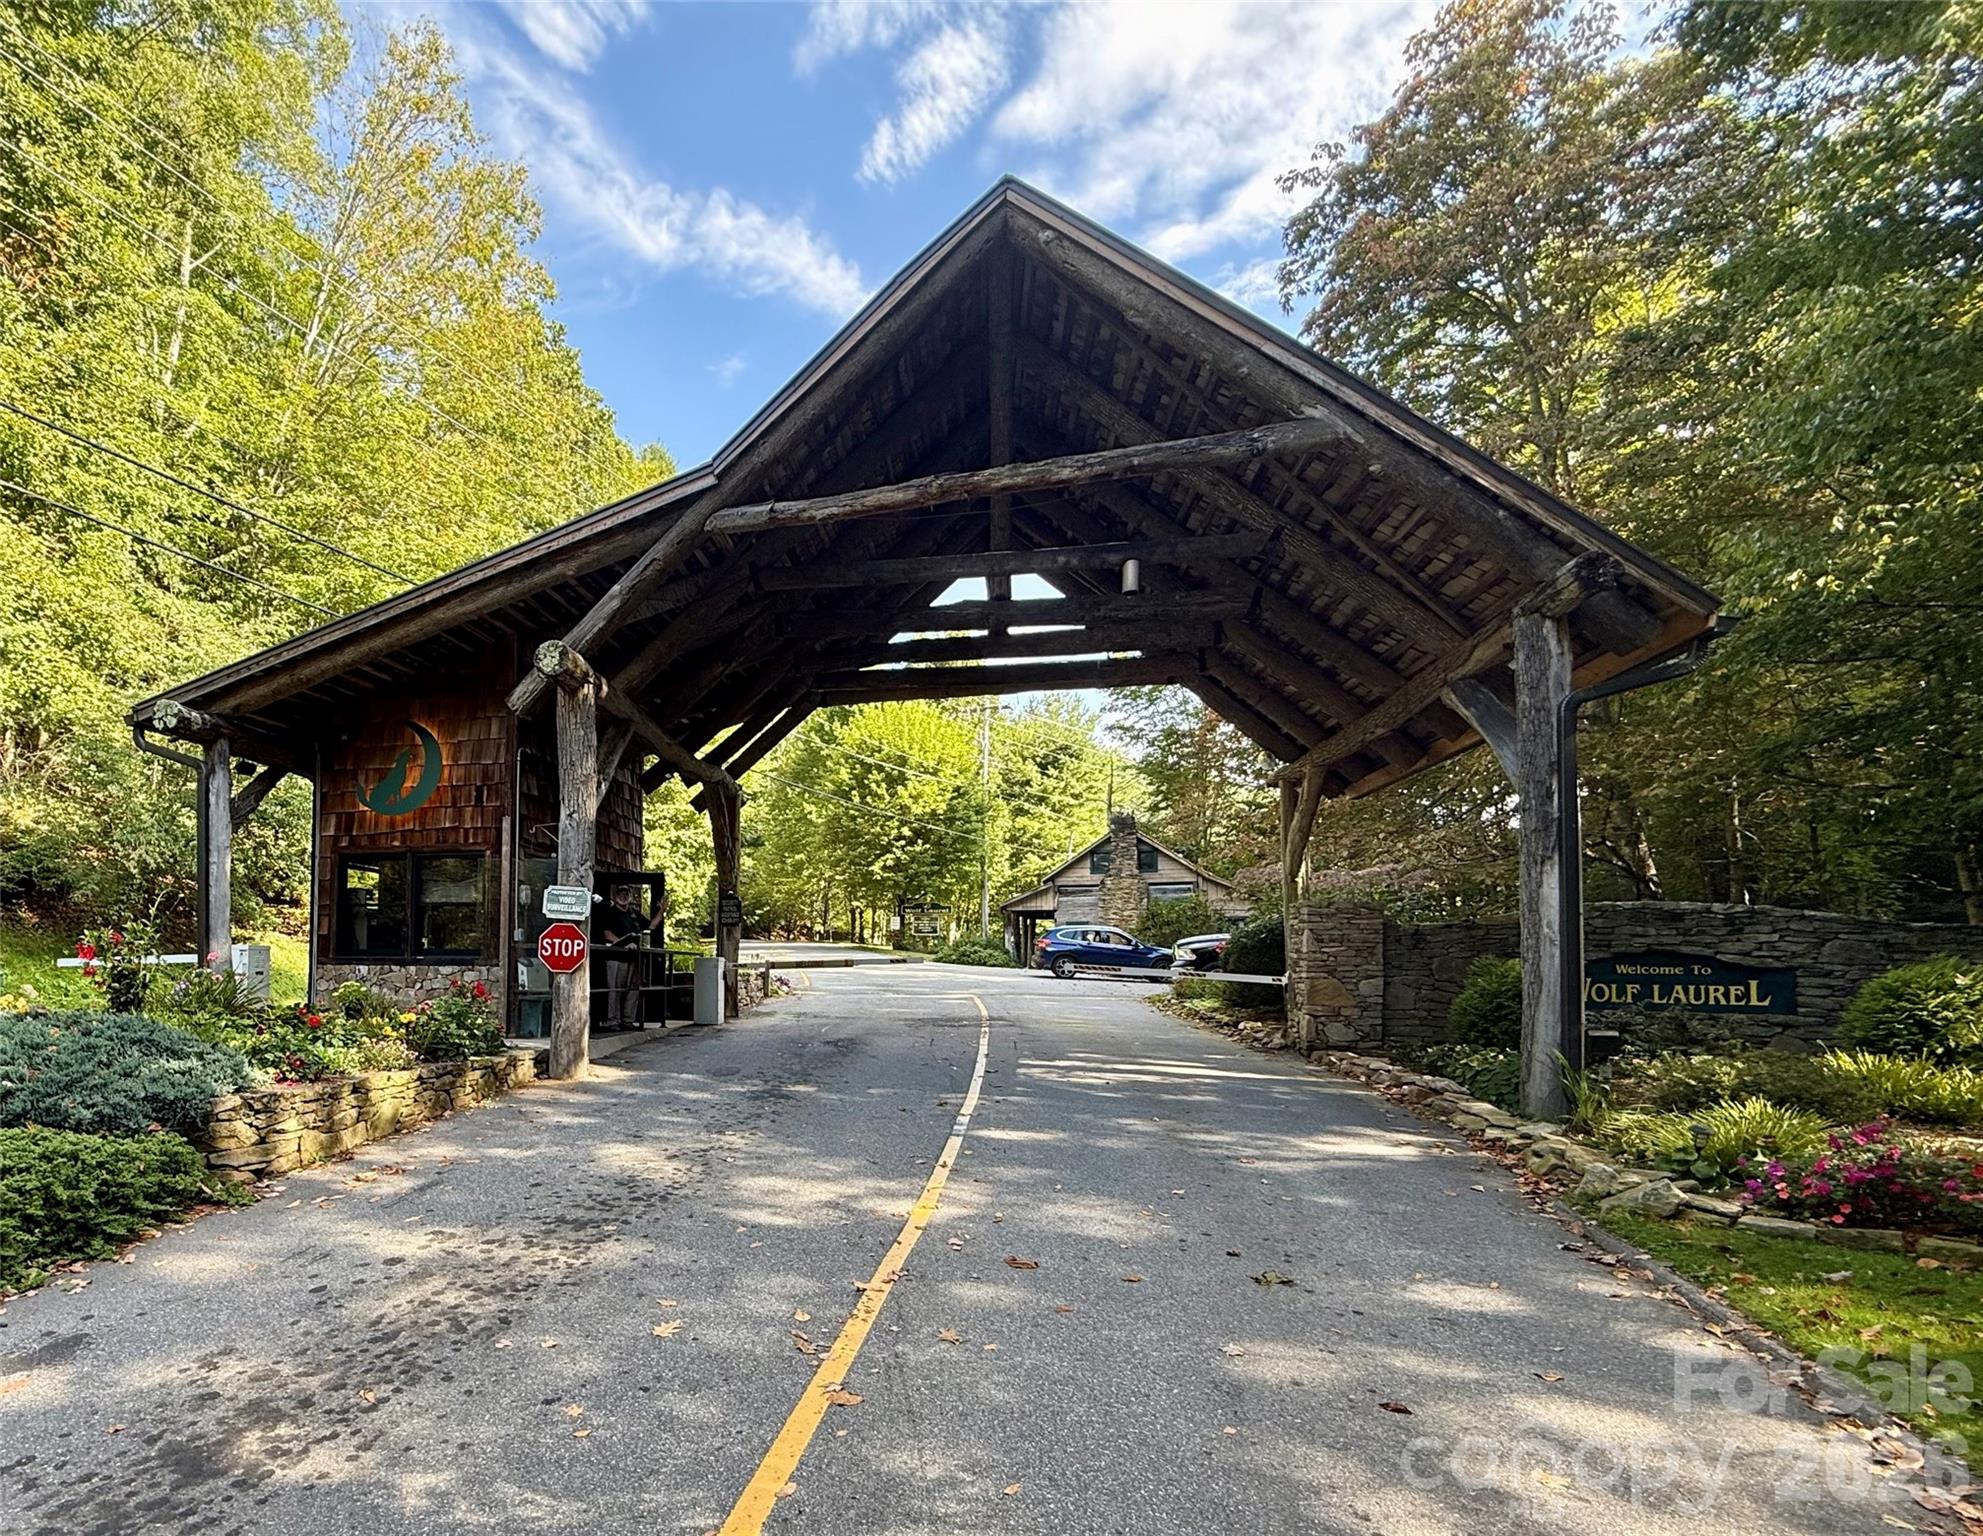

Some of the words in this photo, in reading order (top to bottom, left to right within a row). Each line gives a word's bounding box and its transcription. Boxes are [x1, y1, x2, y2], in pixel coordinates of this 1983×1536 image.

[558, 896, 576, 904] VIDEO
[547, 903, 587, 913] SURVEILLANCE
[541, 938, 584, 957] STOP
[1615, 963, 1684, 976] Welcome
[1691, 964, 1712, 976] To
[1652, 979, 1772, 1007] LAUREL
